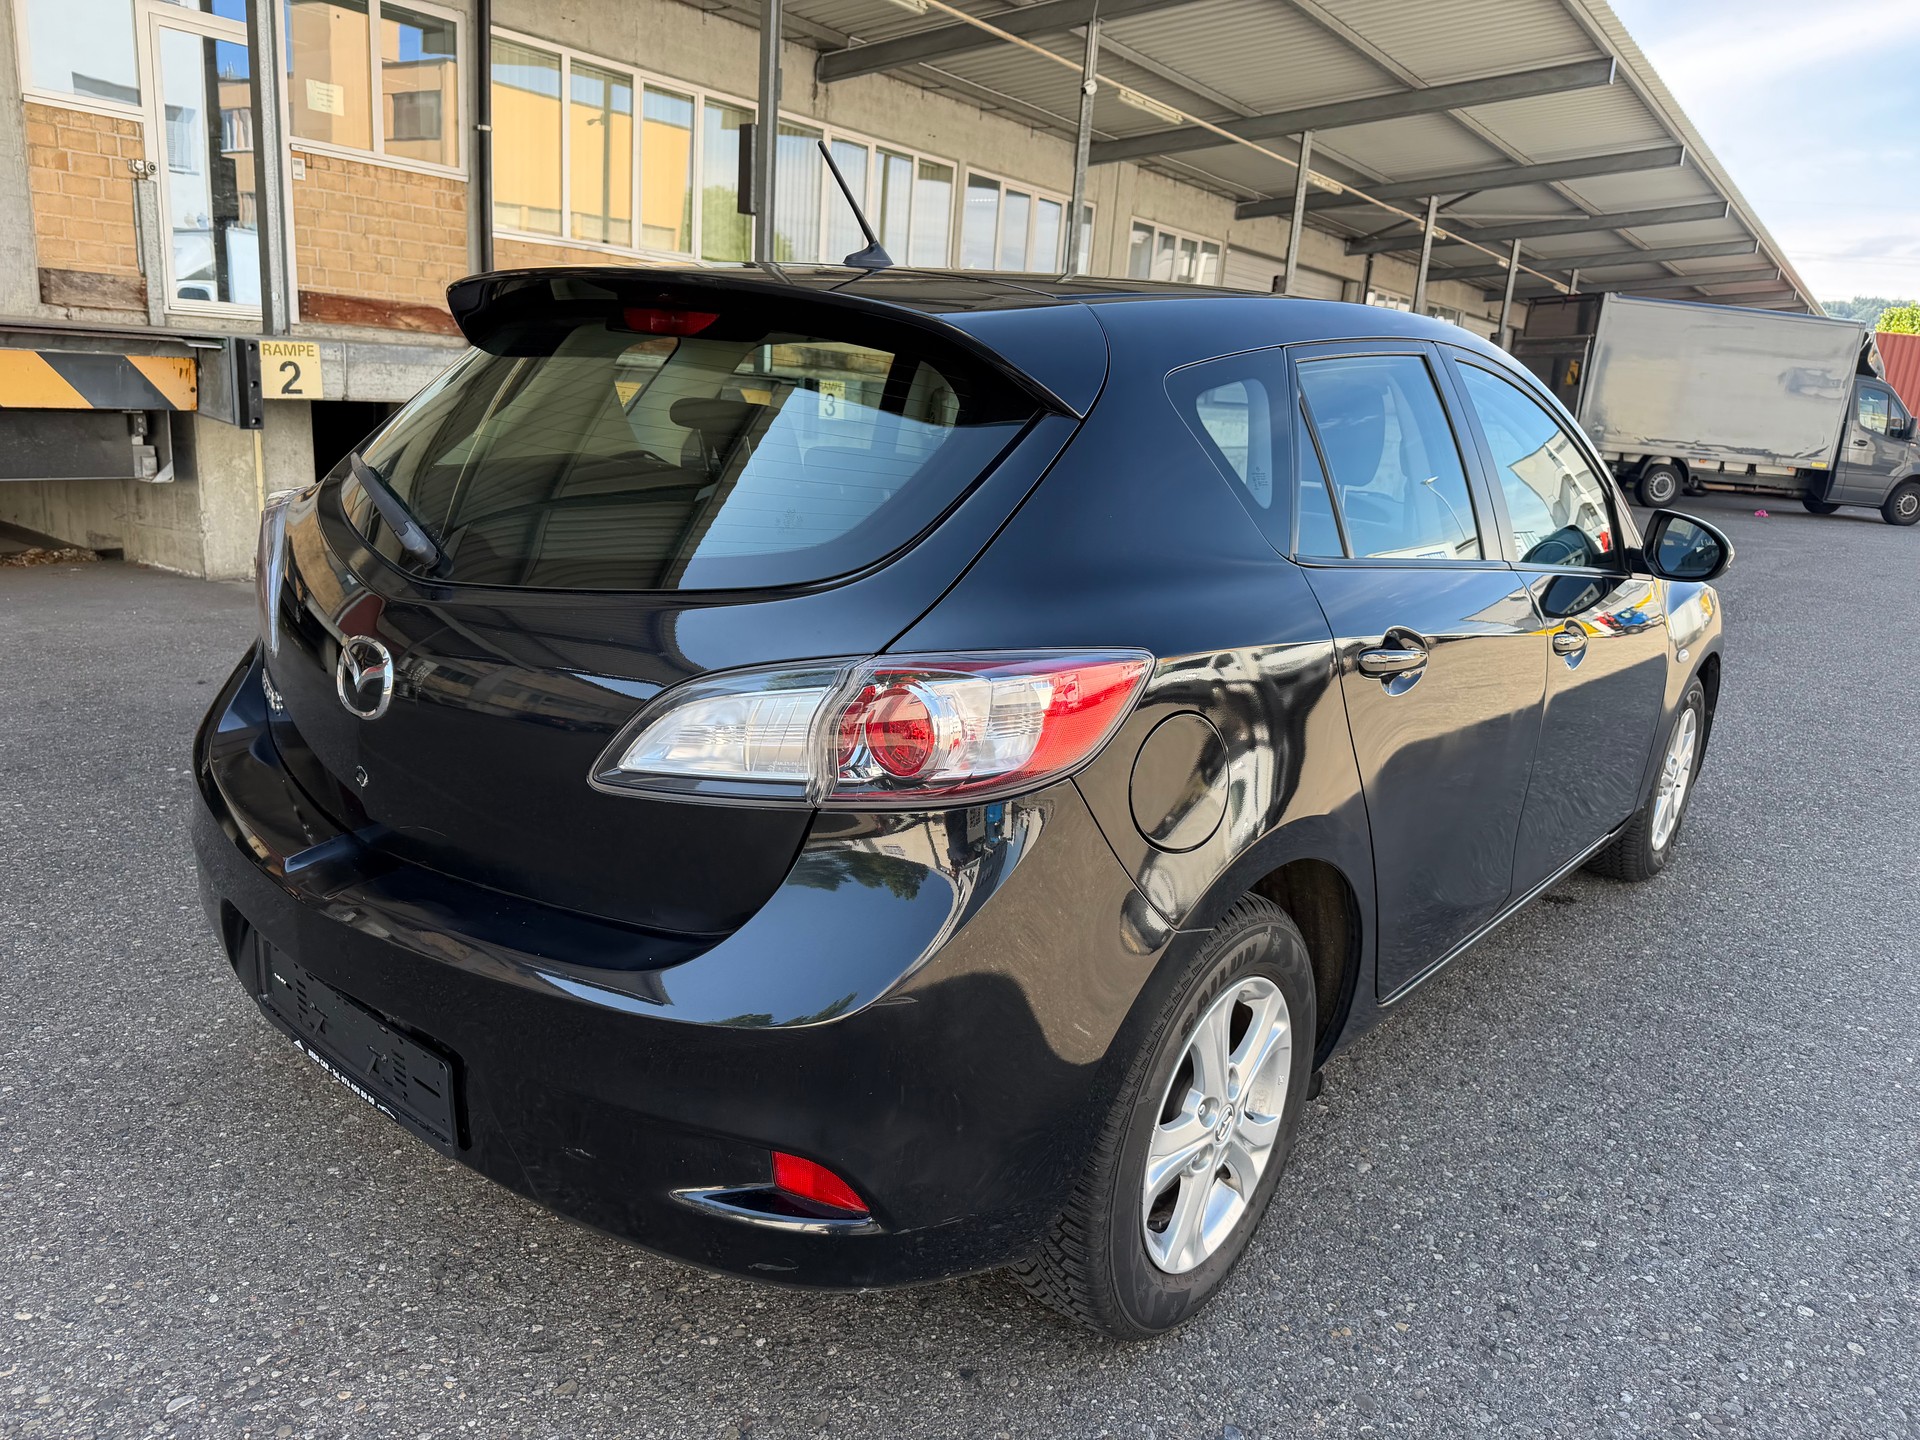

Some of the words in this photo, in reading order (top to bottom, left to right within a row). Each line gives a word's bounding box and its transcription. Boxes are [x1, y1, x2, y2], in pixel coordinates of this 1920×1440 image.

[262, 343, 315, 357] RAMPE
[279, 360, 303, 394] 2
[824, 393, 836, 416] 3
[1181, 942, 1258, 1042] SAILUN
